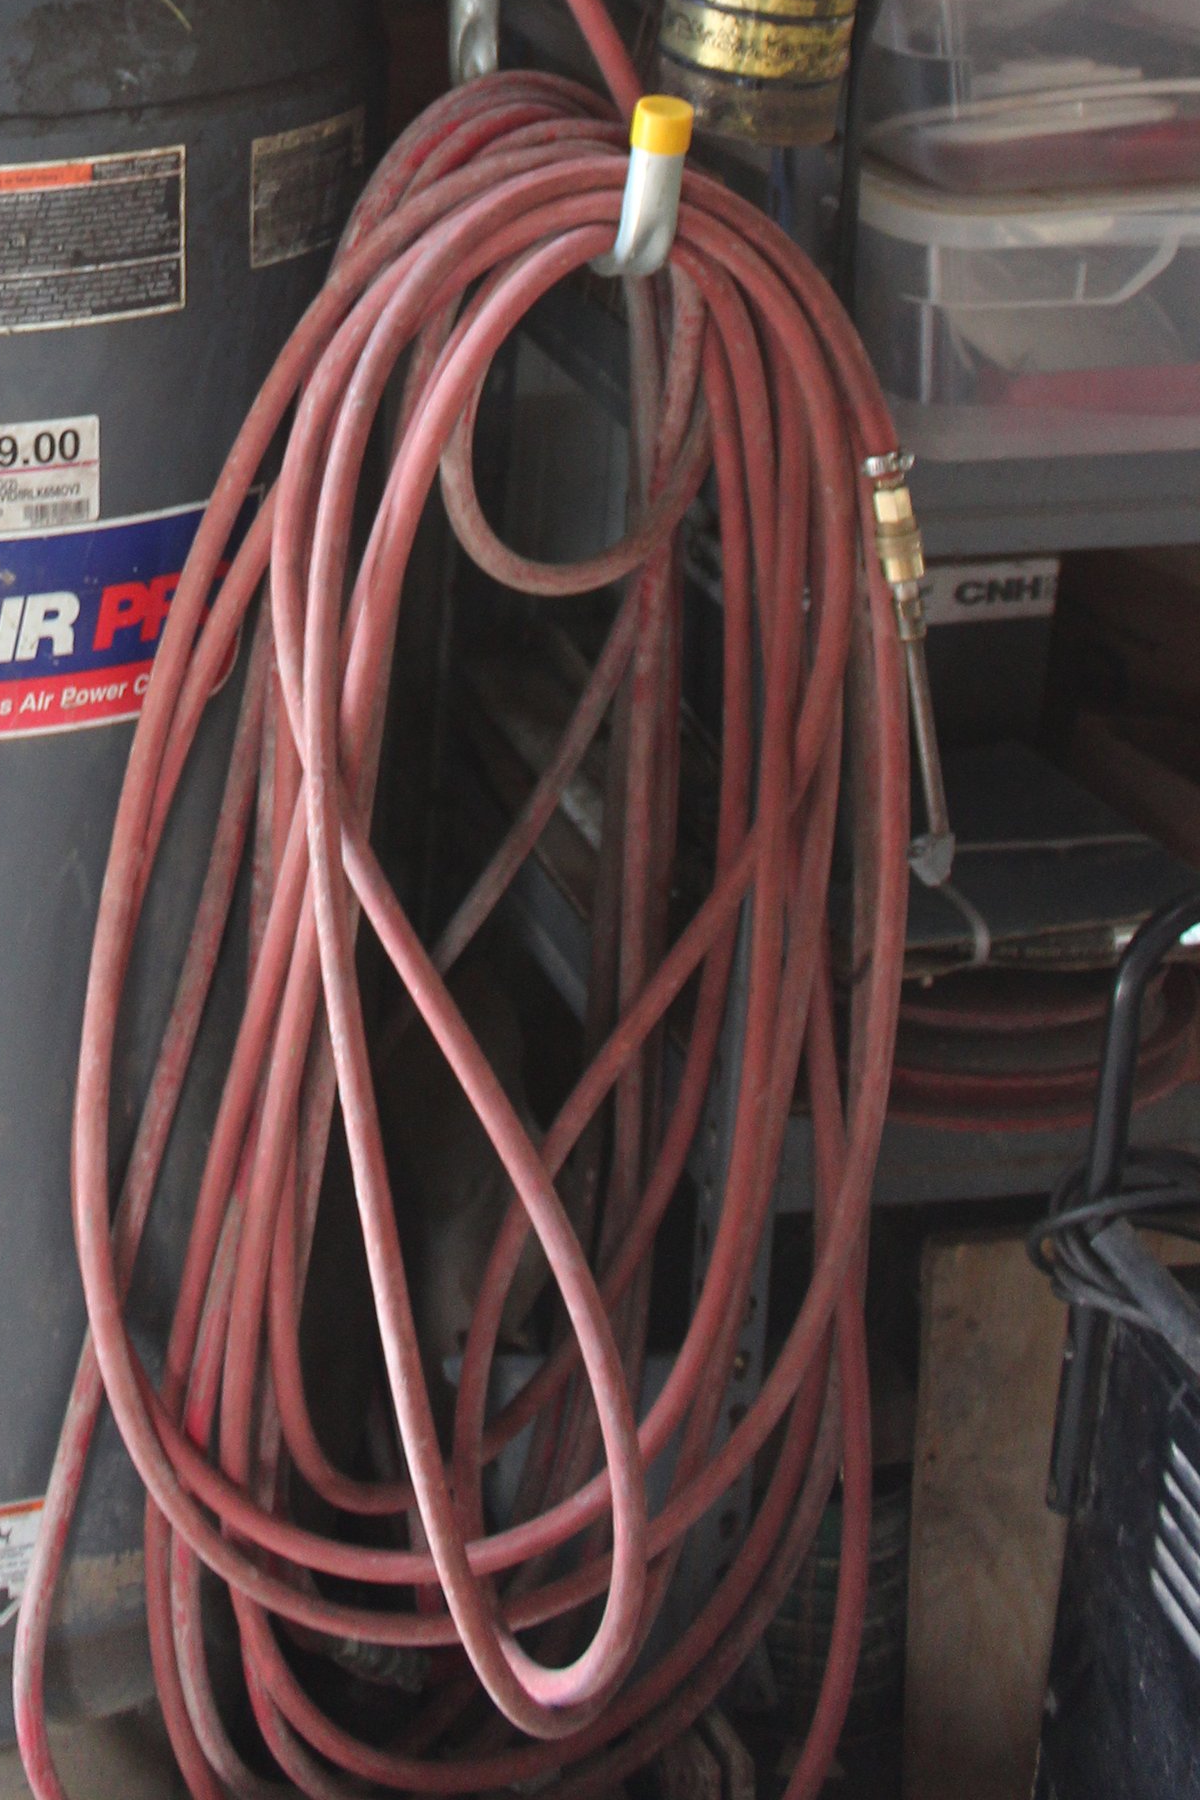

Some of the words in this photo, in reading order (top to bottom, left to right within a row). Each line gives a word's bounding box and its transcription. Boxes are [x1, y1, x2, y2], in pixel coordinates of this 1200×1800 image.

[955, 574, 1043, 606] CNH
[19, 691, 55, 714] Air
[60, 682, 128, 708] Power
